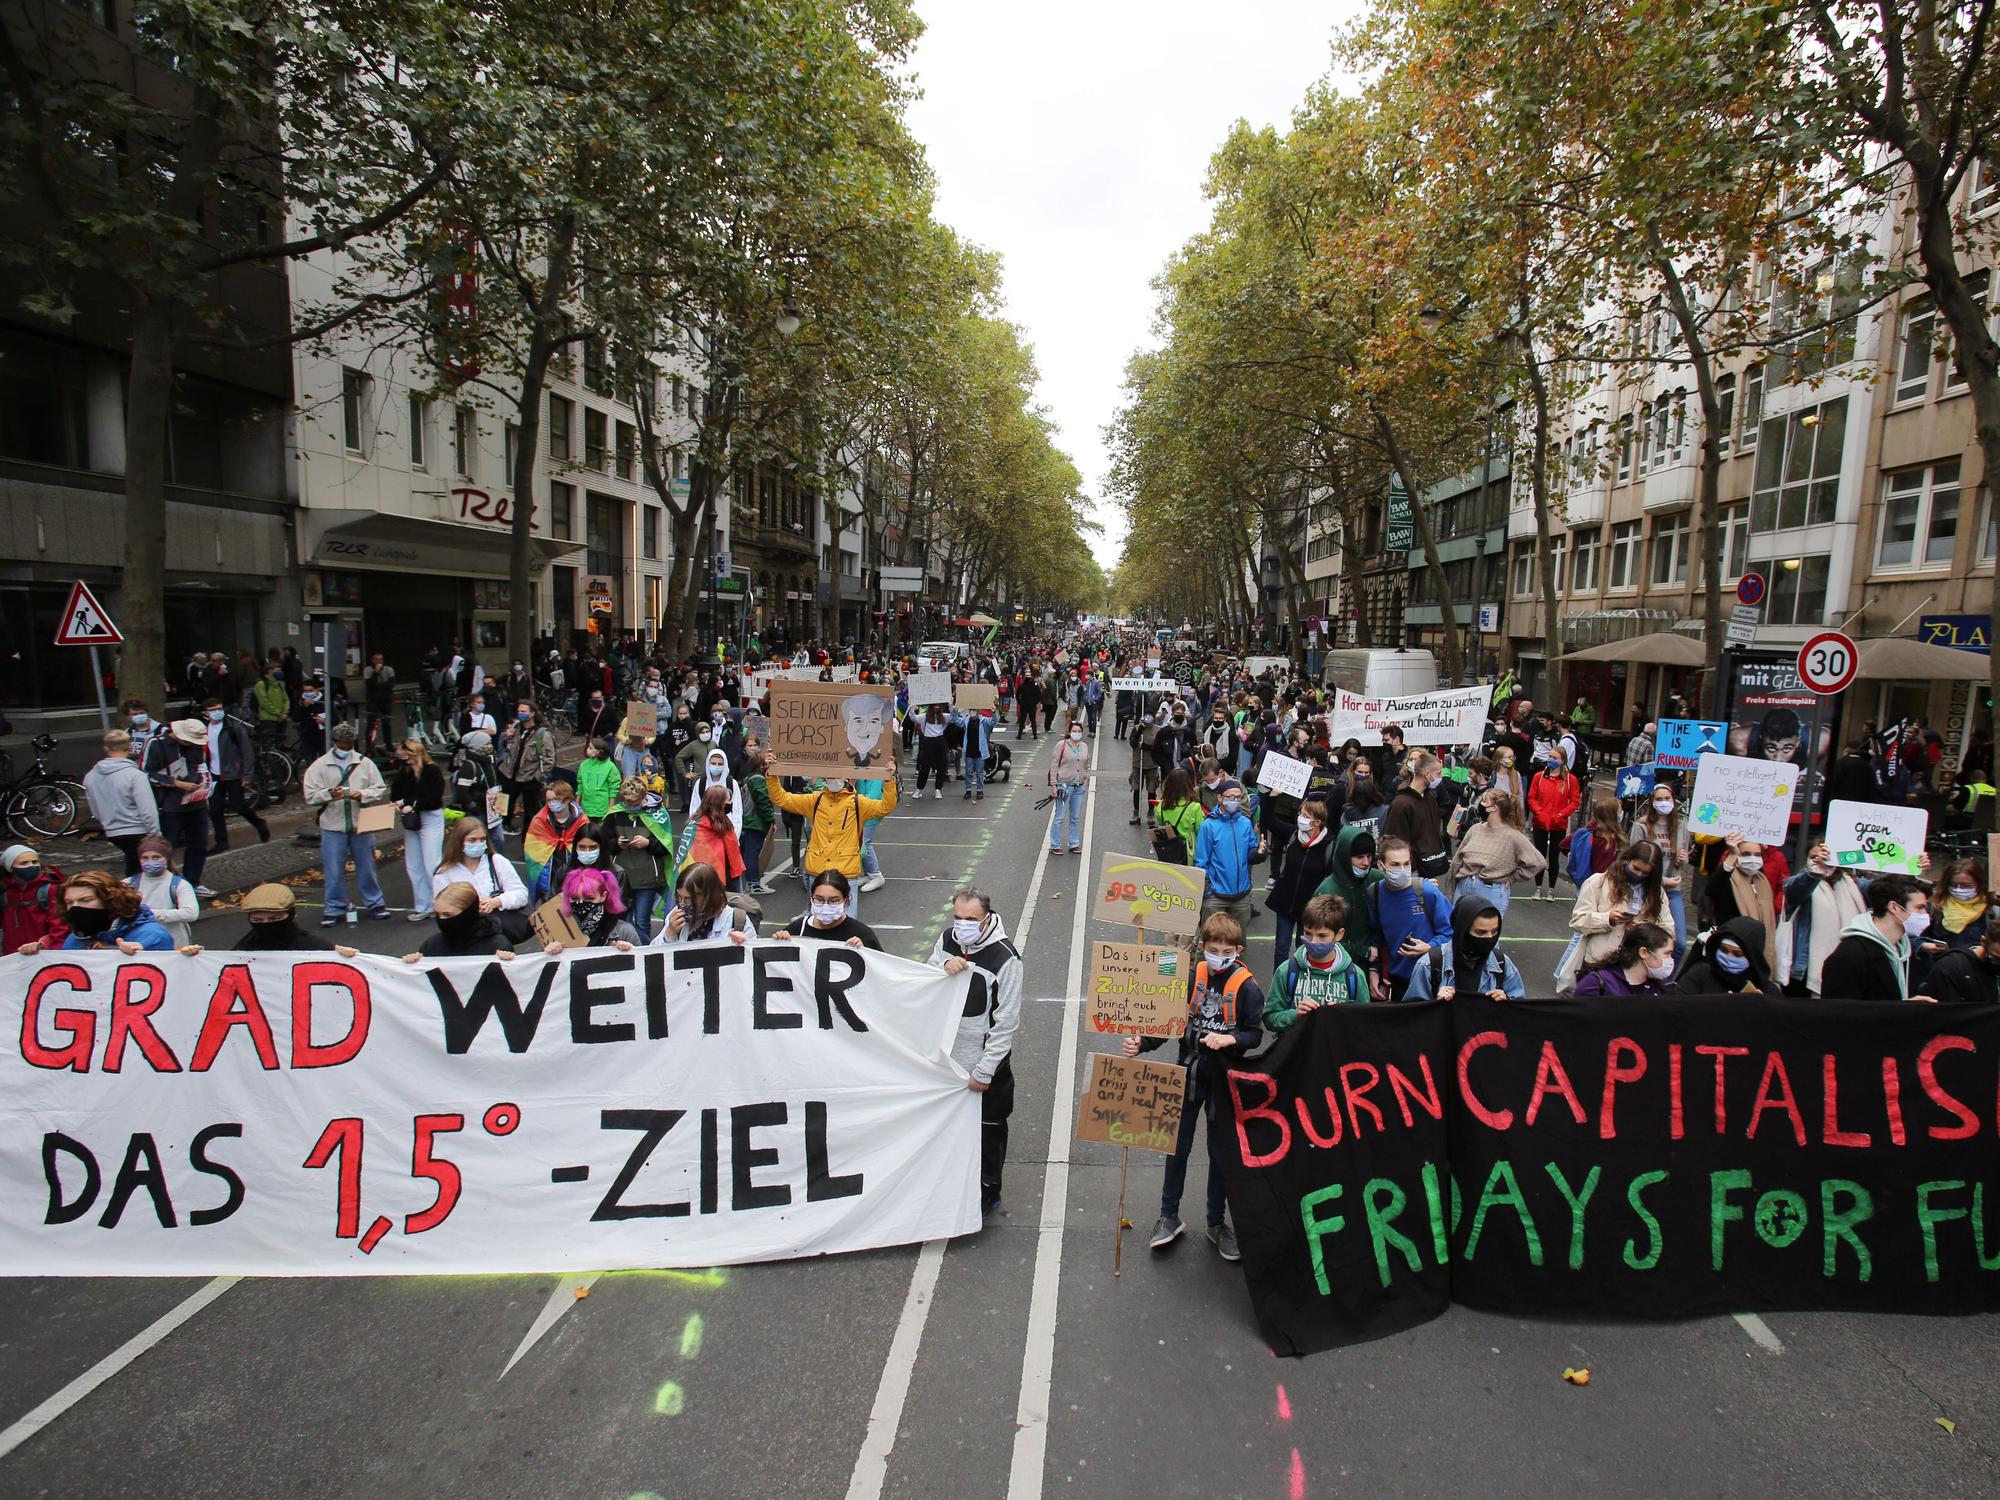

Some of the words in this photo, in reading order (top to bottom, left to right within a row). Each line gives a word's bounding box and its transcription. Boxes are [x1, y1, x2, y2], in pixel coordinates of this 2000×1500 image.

[1389, 528, 1411, 541] BAW
[1924, 621, 1992, 646] PLA
[1810, 649, 1845, 676] 30
[1114, 679, 1174, 688] weniger.
[1741, 671, 1769, 686] mit
[776, 700, 805, 719] SEI
[808, 702, 838, 720] KEIN
[1364, 698, 1382, 711] auf
[1385, 697, 1437, 711] Ausreden
[1440, 700, 1452, 708] zu
[1402, 719, 1414, 728] zu
[1662, 722, 1691, 735] TIME
[778, 723, 840, 746] HORST
[1671, 737, 1681, 749] IS
[1656, 752, 1699, 768] RUNNING
[1713, 766, 1730, 776] no
[1726, 782, 1765, 798] species
[1705, 794, 1737, 805] would
[1742, 798, 1777, 816] destroy
[1855, 822, 1892, 841] green
[1104, 881, 1137, 903] go
[1142, 884, 1197, 912] vegan
[1102, 945, 1129, 961] Das
[1140, 950, 1157, 963] ist
[1102, 964, 1139, 975] unsere
[1096, 975, 1188, 1003] Zukunft
[19, 961, 372, 1074] GRAD
[426, 946, 869, 1055] WEITER
[1097, 994, 1128, 1014] bringt
[1133, 1000, 1157, 1011] euch
[1092, 1013, 1185, 1036] Vernunft
[1097, 1010, 1133, 1022] endlich
[1138, 1015, 1156, 1024] zur
[1133, 1065, 1182, 1088] climate
[1097, 1089, 1125, 1102] and
[1131, 1094, 1156, 1109] real
[1099, 1078, 1128, 1091] crisis
[1135, 1081, 1147, 1094] is
[1153, 1086, 1182, 1105] here
[1227, 1054, 1443, 1168] BURN
[1458, 1031, 2000, 1147] CAPITALIS
[1109, 1121, 1170, 1148] Earth
[42, 1122, 245, 1229] DAS
[1710, 1169, 1873, 1282] FOR
